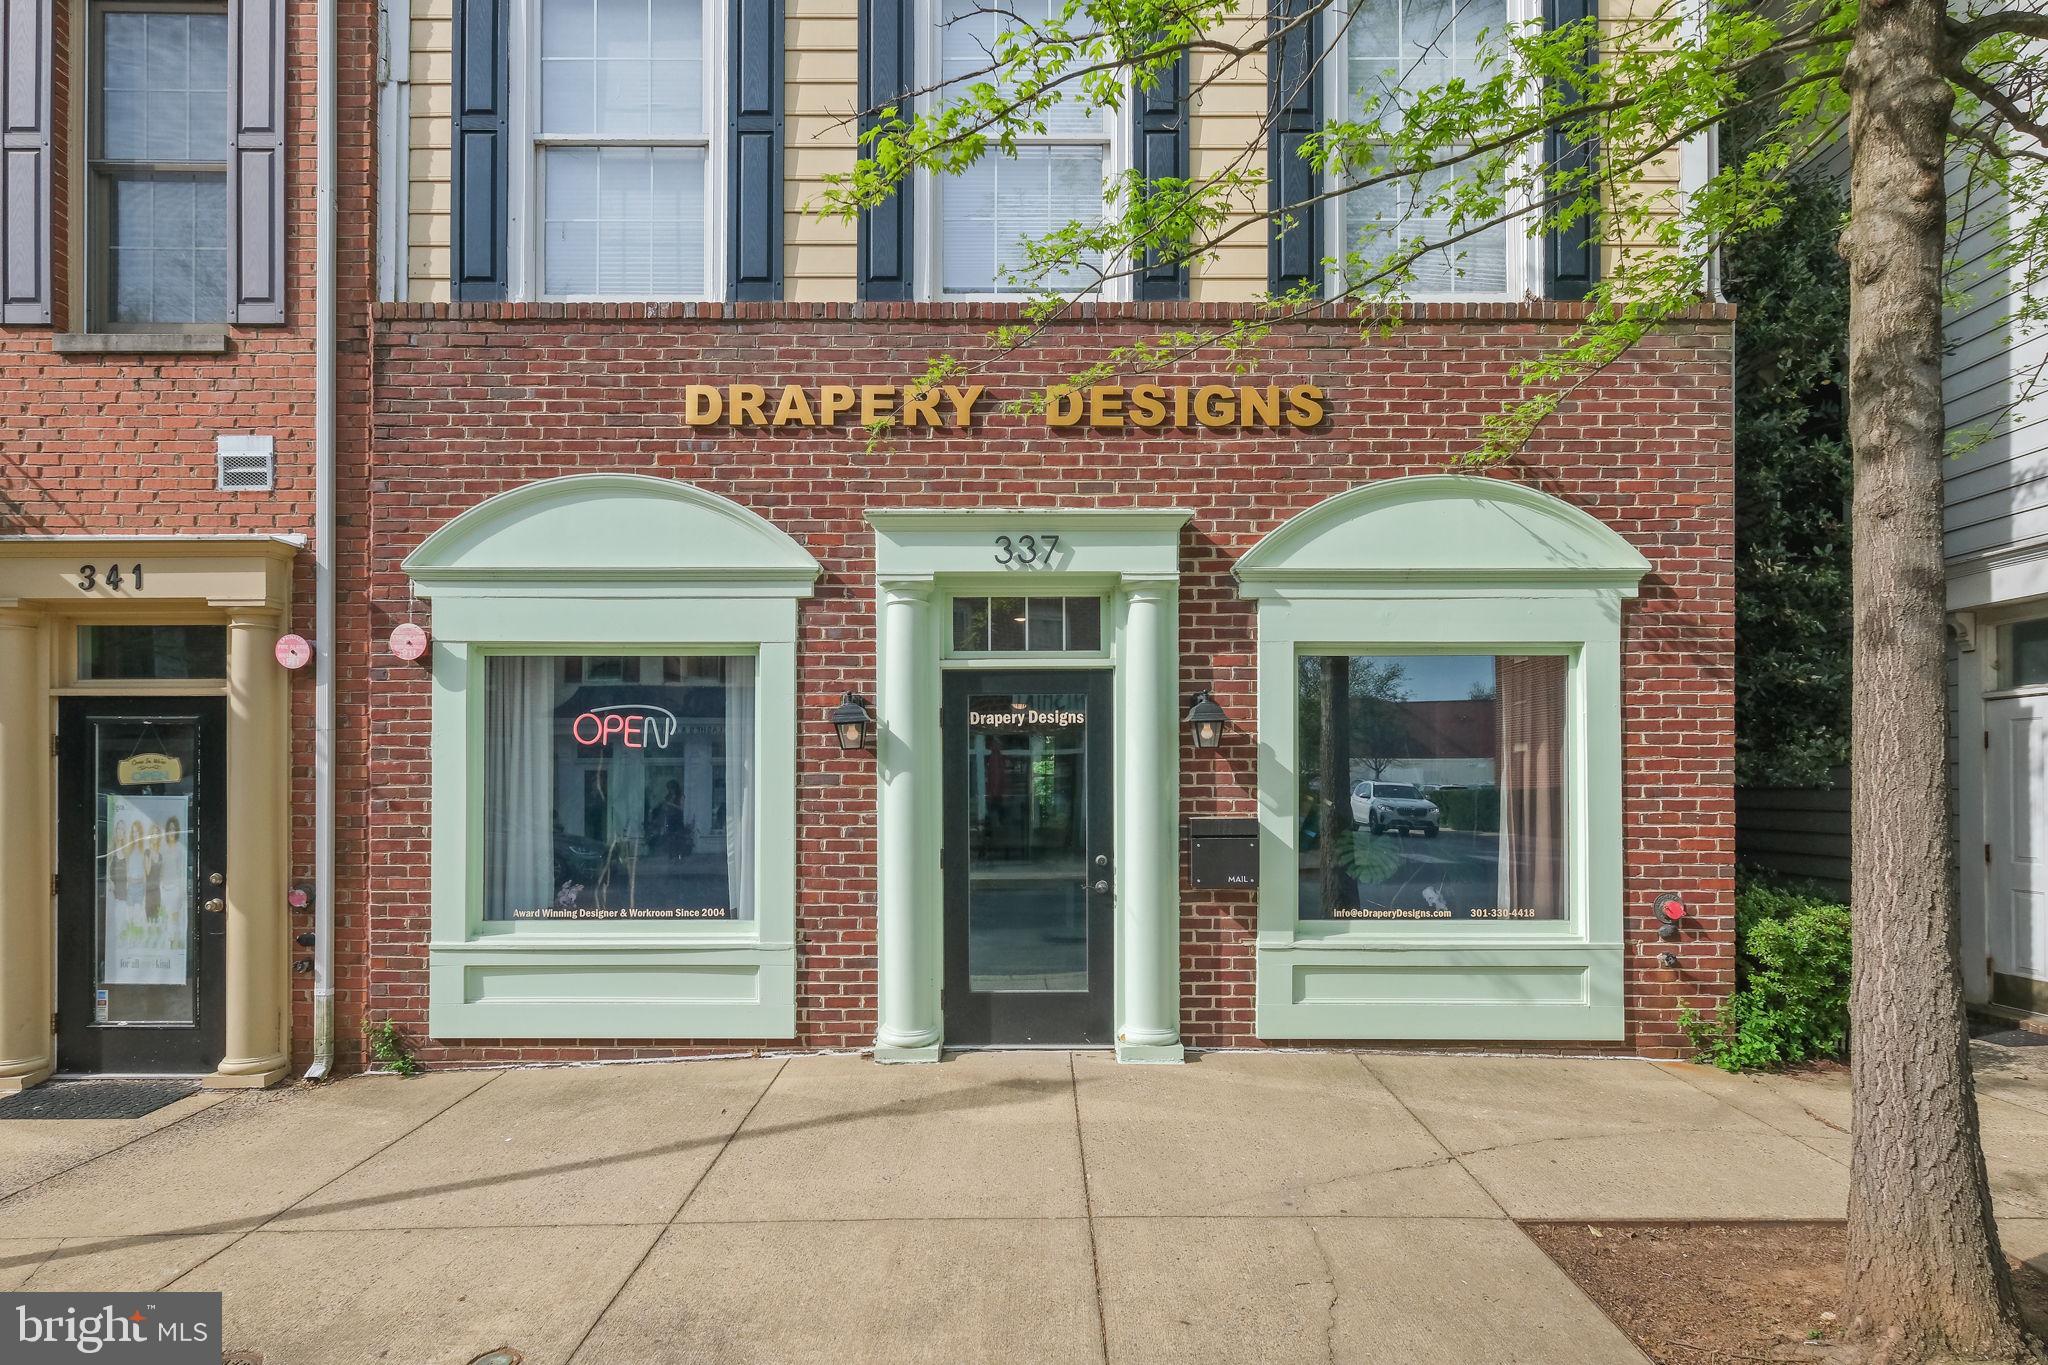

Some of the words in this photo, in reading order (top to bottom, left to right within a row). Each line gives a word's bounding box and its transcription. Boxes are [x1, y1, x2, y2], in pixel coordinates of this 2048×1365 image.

[685, 384, 984, 427] DRAPERY
[1046, 384, 1325, 427] DESIGNS
[995, 535, 1059, 565] 337
[79, 564, 143, 590] 341
[573, 712, 669, 749] OPEN
[970, 711, 1025, 727] Drapery
[1028, 710, 1085, 726] Designs
[513, 908, 540, 917] Award
[542, 908, 577, 919] Winning
[579, 908, 618, 919] Designer
[620, 908, 627, 917] &
[629, 908, 673, 917] Workroom
[675, 908, 699, 917] Since
[701, 908, 725, 917] 2004
[1470, 908, 1535, 918] 301-330-4418
